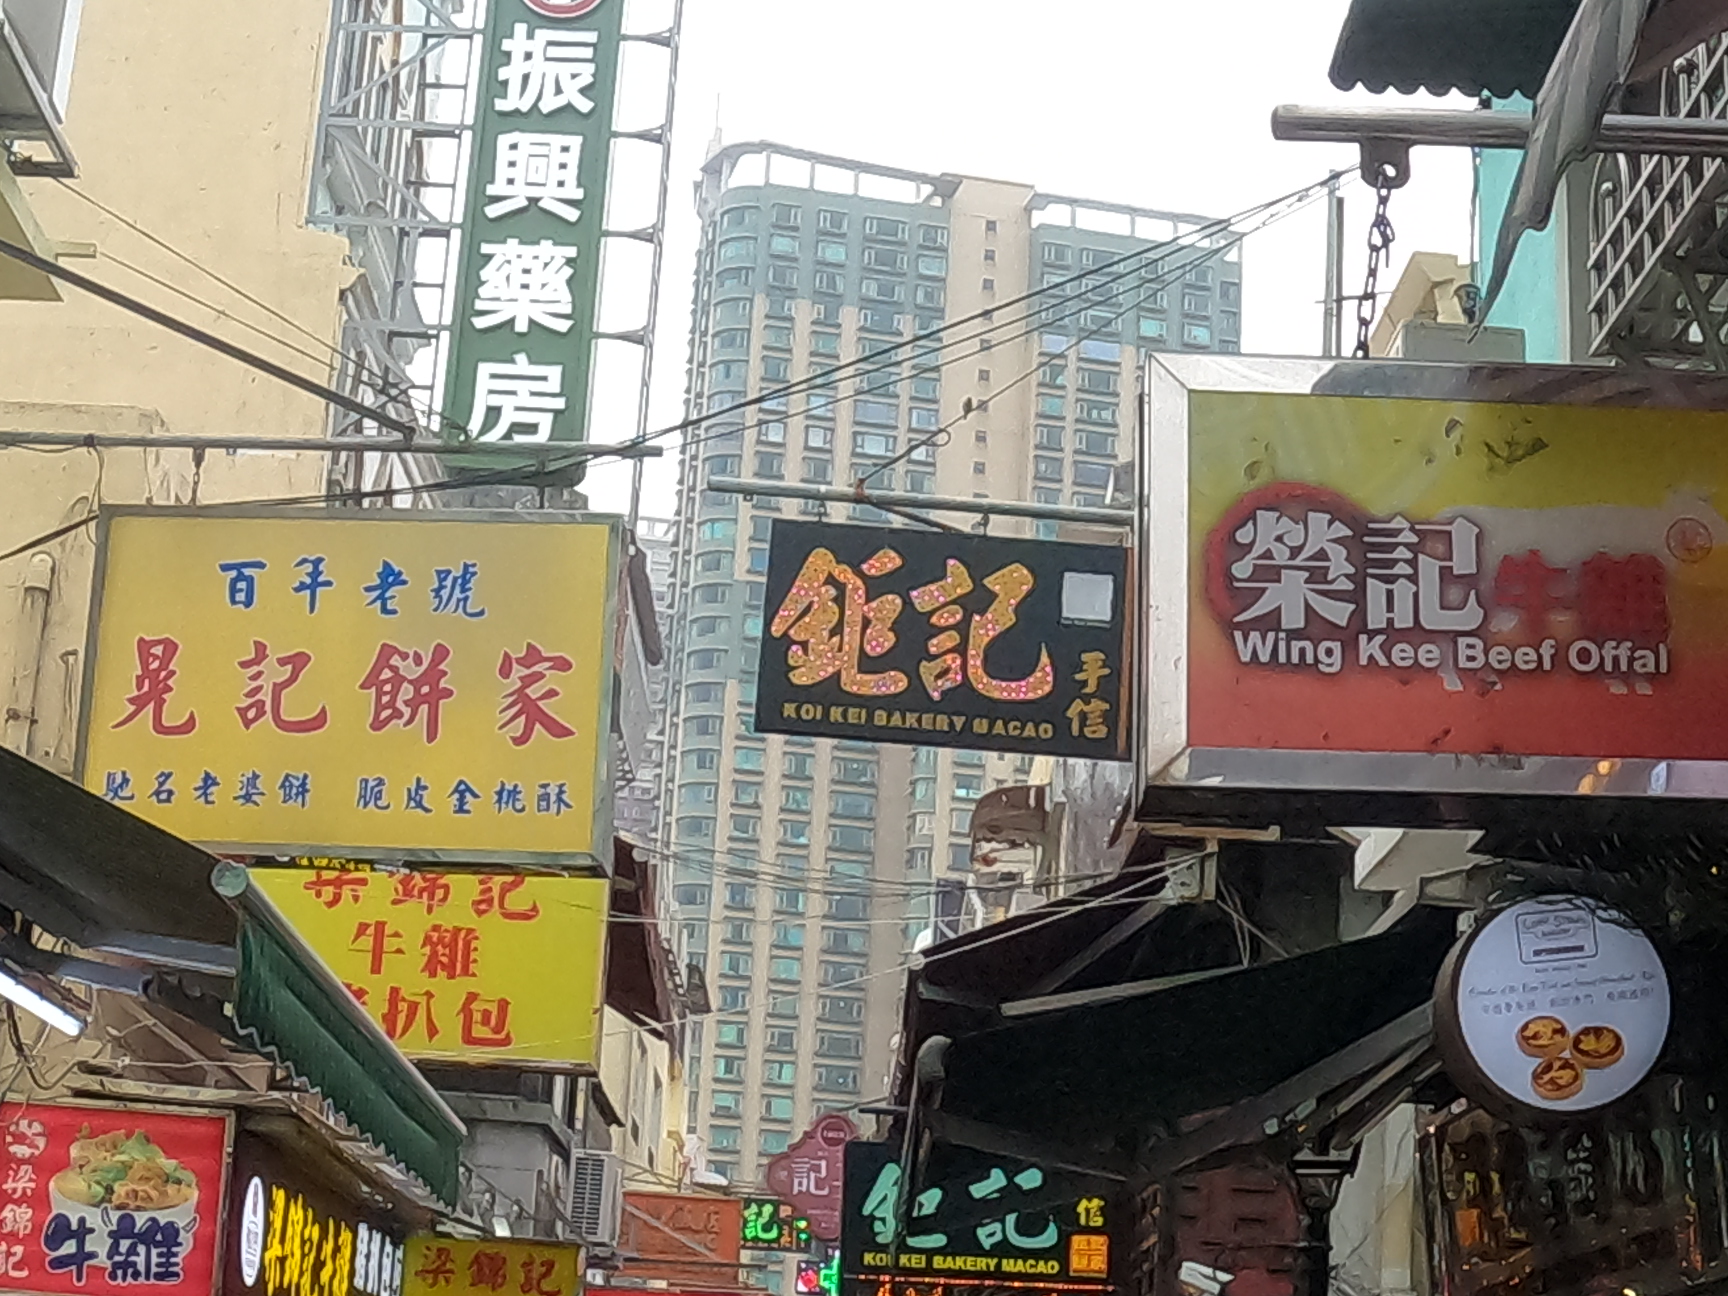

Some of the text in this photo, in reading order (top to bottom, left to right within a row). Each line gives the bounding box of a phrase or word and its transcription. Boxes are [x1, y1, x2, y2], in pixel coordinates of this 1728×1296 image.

[469, 21, 600, 443] 振興藥房
[217, 555, 488, 620] 百年老號
[1230, 509, 1486, 632] 榮記
[771, 547, 1055, 702] 鉅記
[1232, 630, 1671, 675] Wing Kee Beef Offal
[782, 702, 1055, 740] KOI KEI BAKERY MACAO
[1065, 651, 1111, 739] 手信
[103, 768, 575, 816] 馳名老婆餅 脆皮金桃酥
[347, 919, 480, 981] 牛雜
[342, 980, 515, 1048] 扒包
[42, 1211, 185, 1285] 牛雜
[899, 1253, 926, 1268] KEI
[932, 1256, 999, 1271] BAKERY
[1001, 1259, 1060, 1275] MACAO
